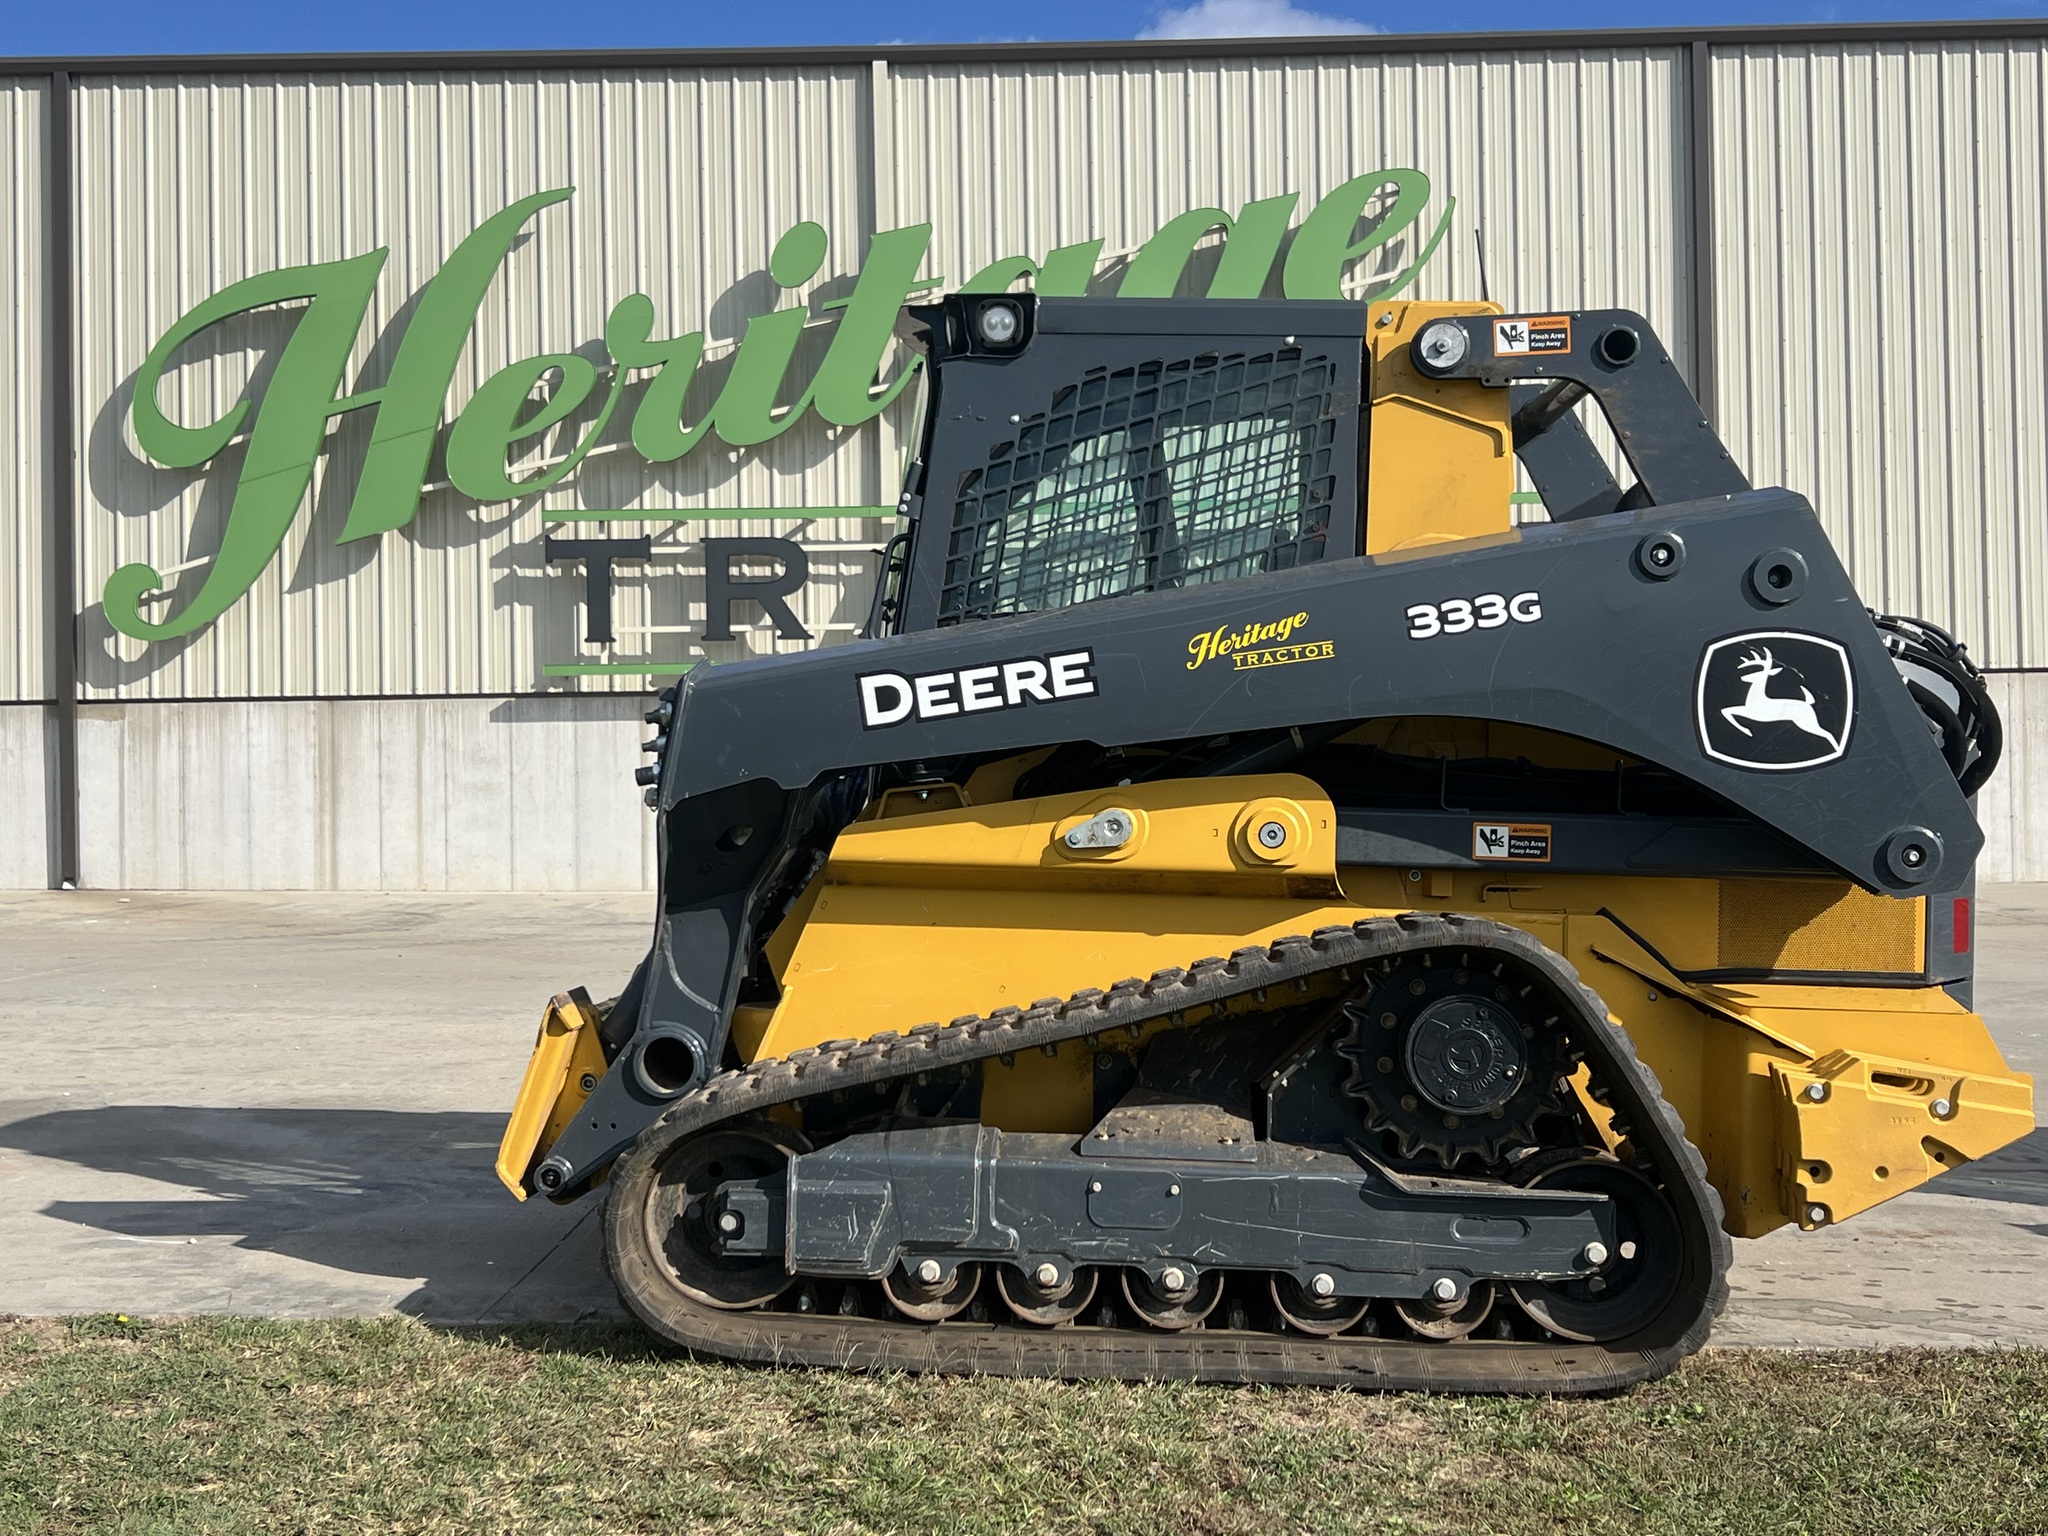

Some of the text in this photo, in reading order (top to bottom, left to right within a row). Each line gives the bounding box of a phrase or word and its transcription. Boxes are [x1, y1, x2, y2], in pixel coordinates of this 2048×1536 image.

[1537, 319, 1566, 327] WARNING
[1550, 332, 1566, 340] Area
[1406, 592, 1542, 639] 333G
[1186, 611, 1310, 670] Heritage
[1232, 644, 1334, 668] TRACTOR
[860, 651, 1094, 727] DEERE
